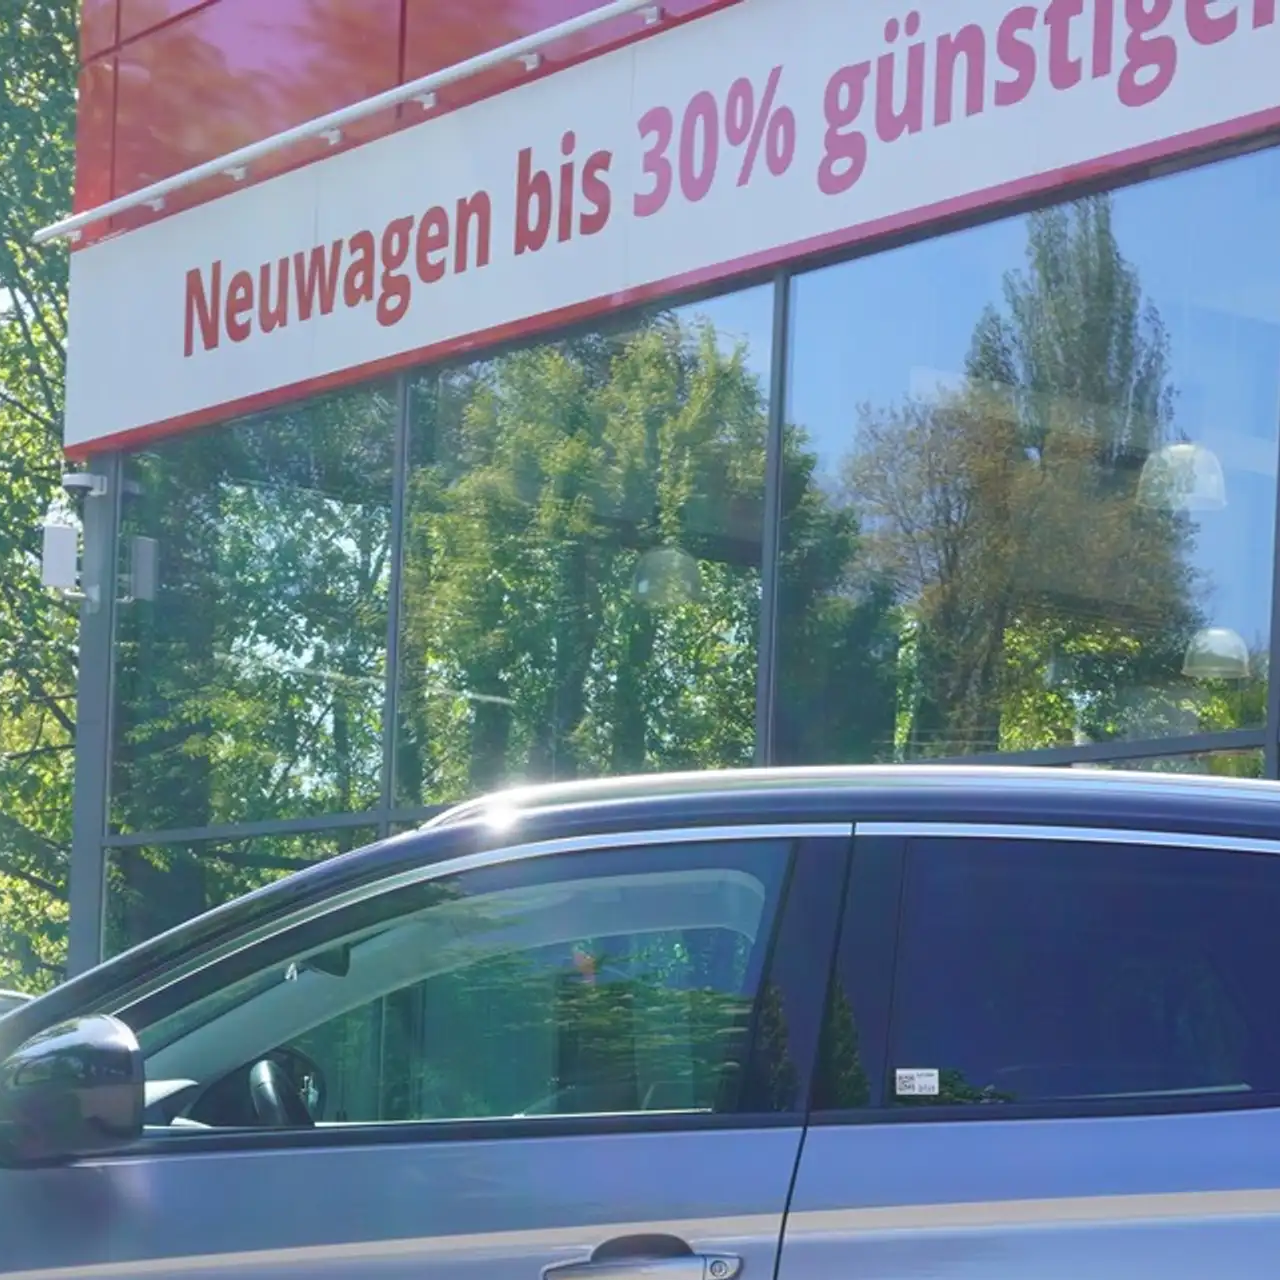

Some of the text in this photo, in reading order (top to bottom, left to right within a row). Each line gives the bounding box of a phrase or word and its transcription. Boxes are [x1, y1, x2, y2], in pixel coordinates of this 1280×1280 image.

[184, 0, 1275, 356] Neuwagen bis 30% günstig
